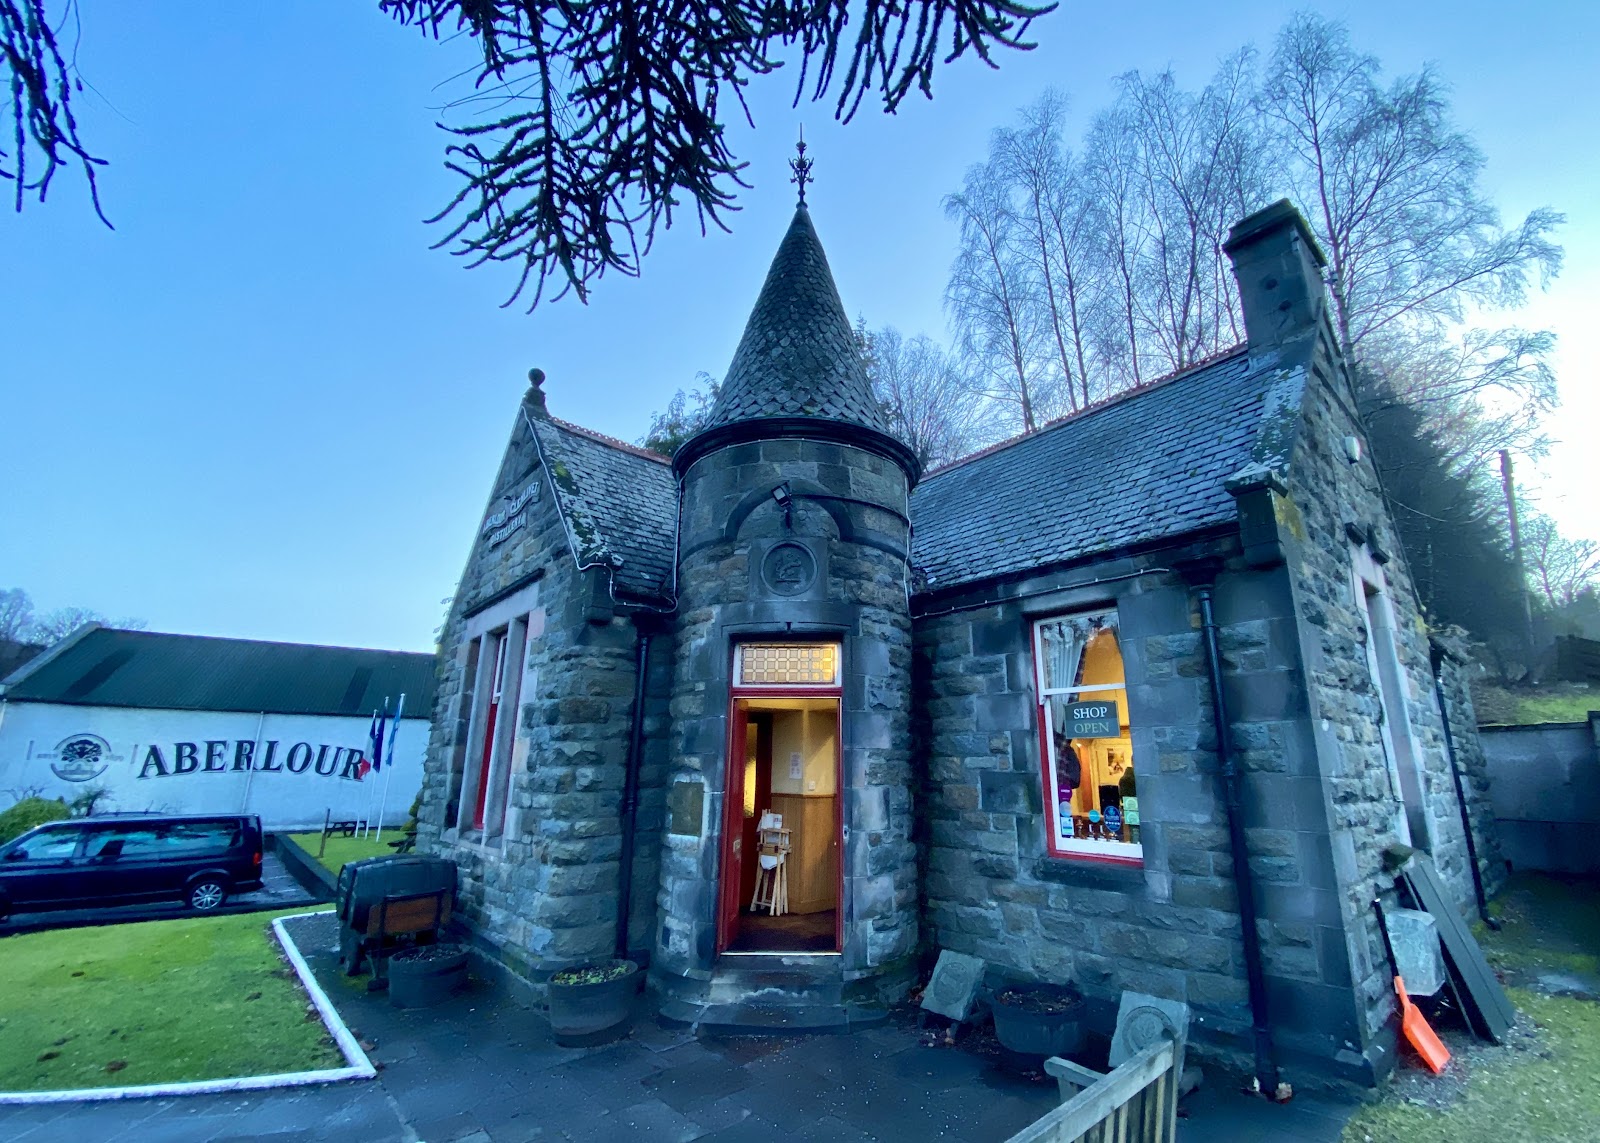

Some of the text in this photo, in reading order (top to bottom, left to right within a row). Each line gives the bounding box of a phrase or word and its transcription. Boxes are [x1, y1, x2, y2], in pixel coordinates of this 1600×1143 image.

[1073, 706, 1107, 720] SHOP
[1074, 722, 1110, 734] OPEN
[136, 739, 366, 783] ABERLOUR
